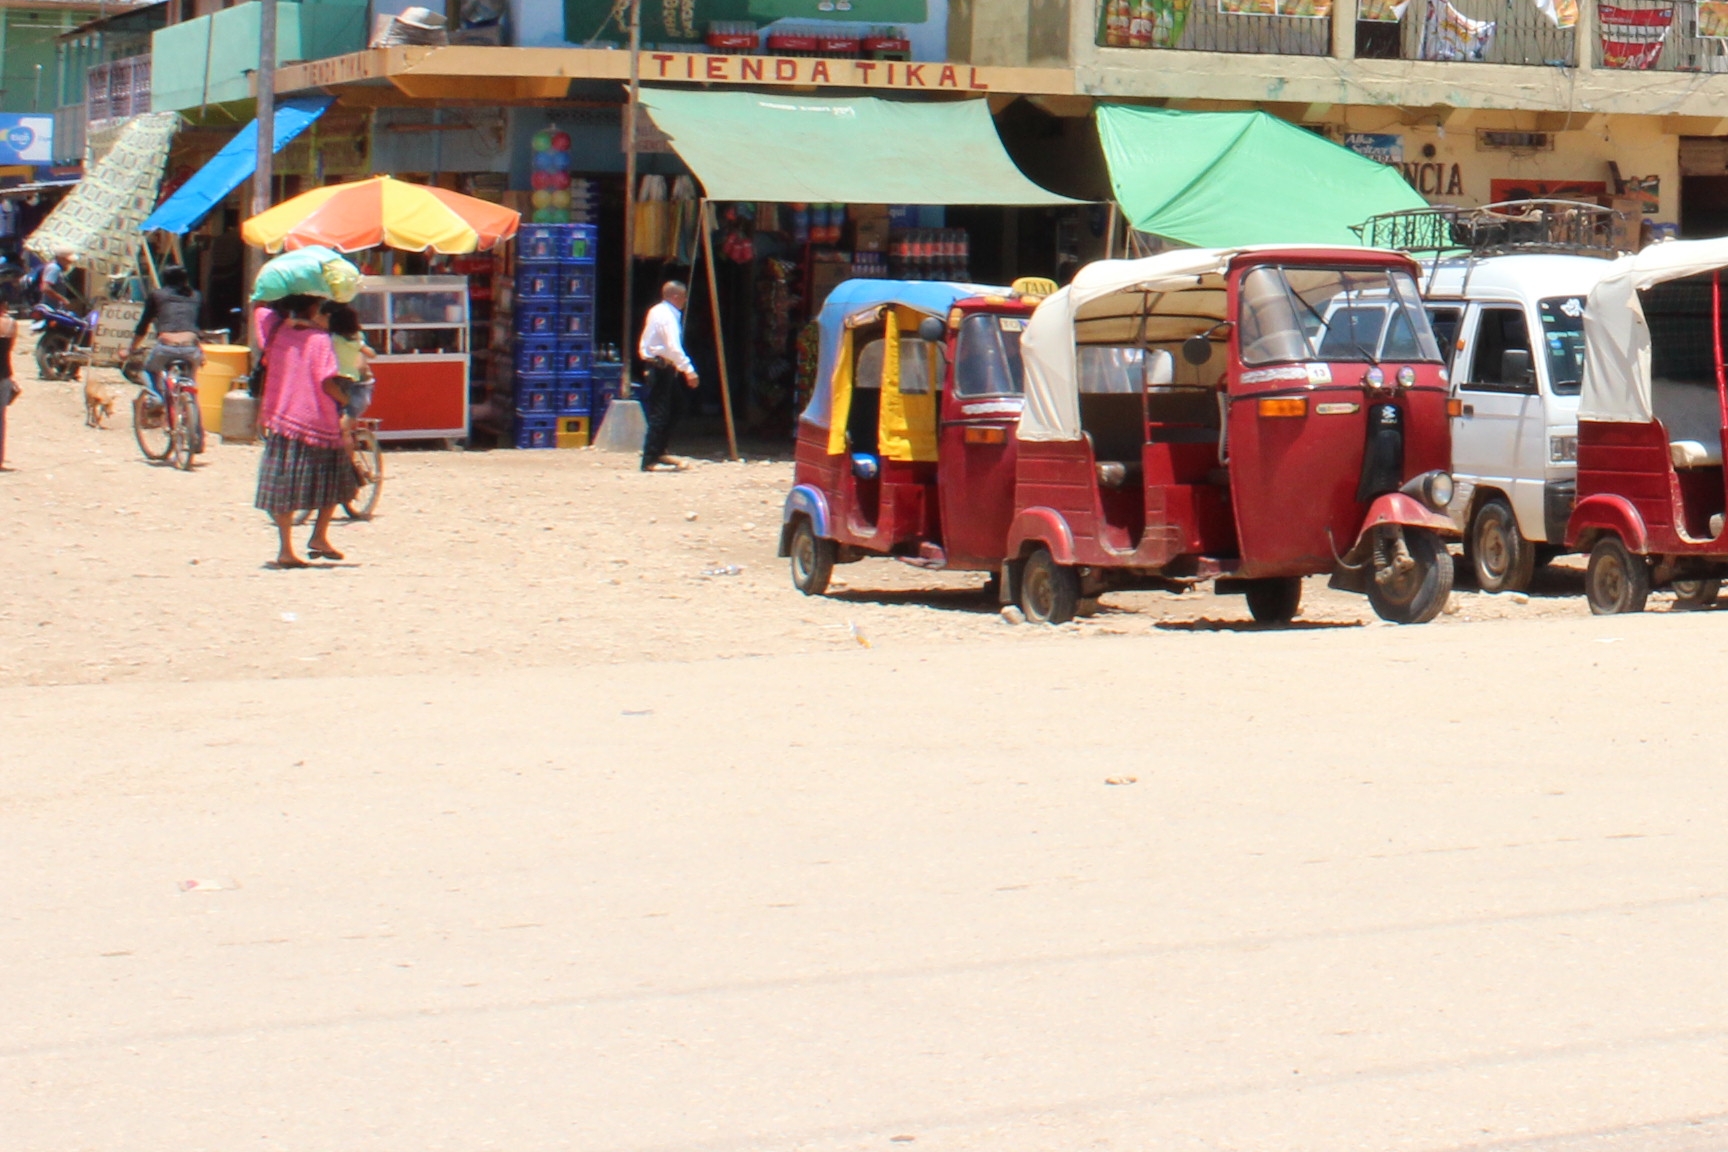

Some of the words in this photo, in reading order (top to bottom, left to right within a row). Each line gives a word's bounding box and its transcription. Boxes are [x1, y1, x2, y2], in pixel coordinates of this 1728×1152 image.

[651, 54, 831, 83] TIENDA
[855, 62, 989, 90] TIKAL
[1022, 281, 1055, 294] TAXI
